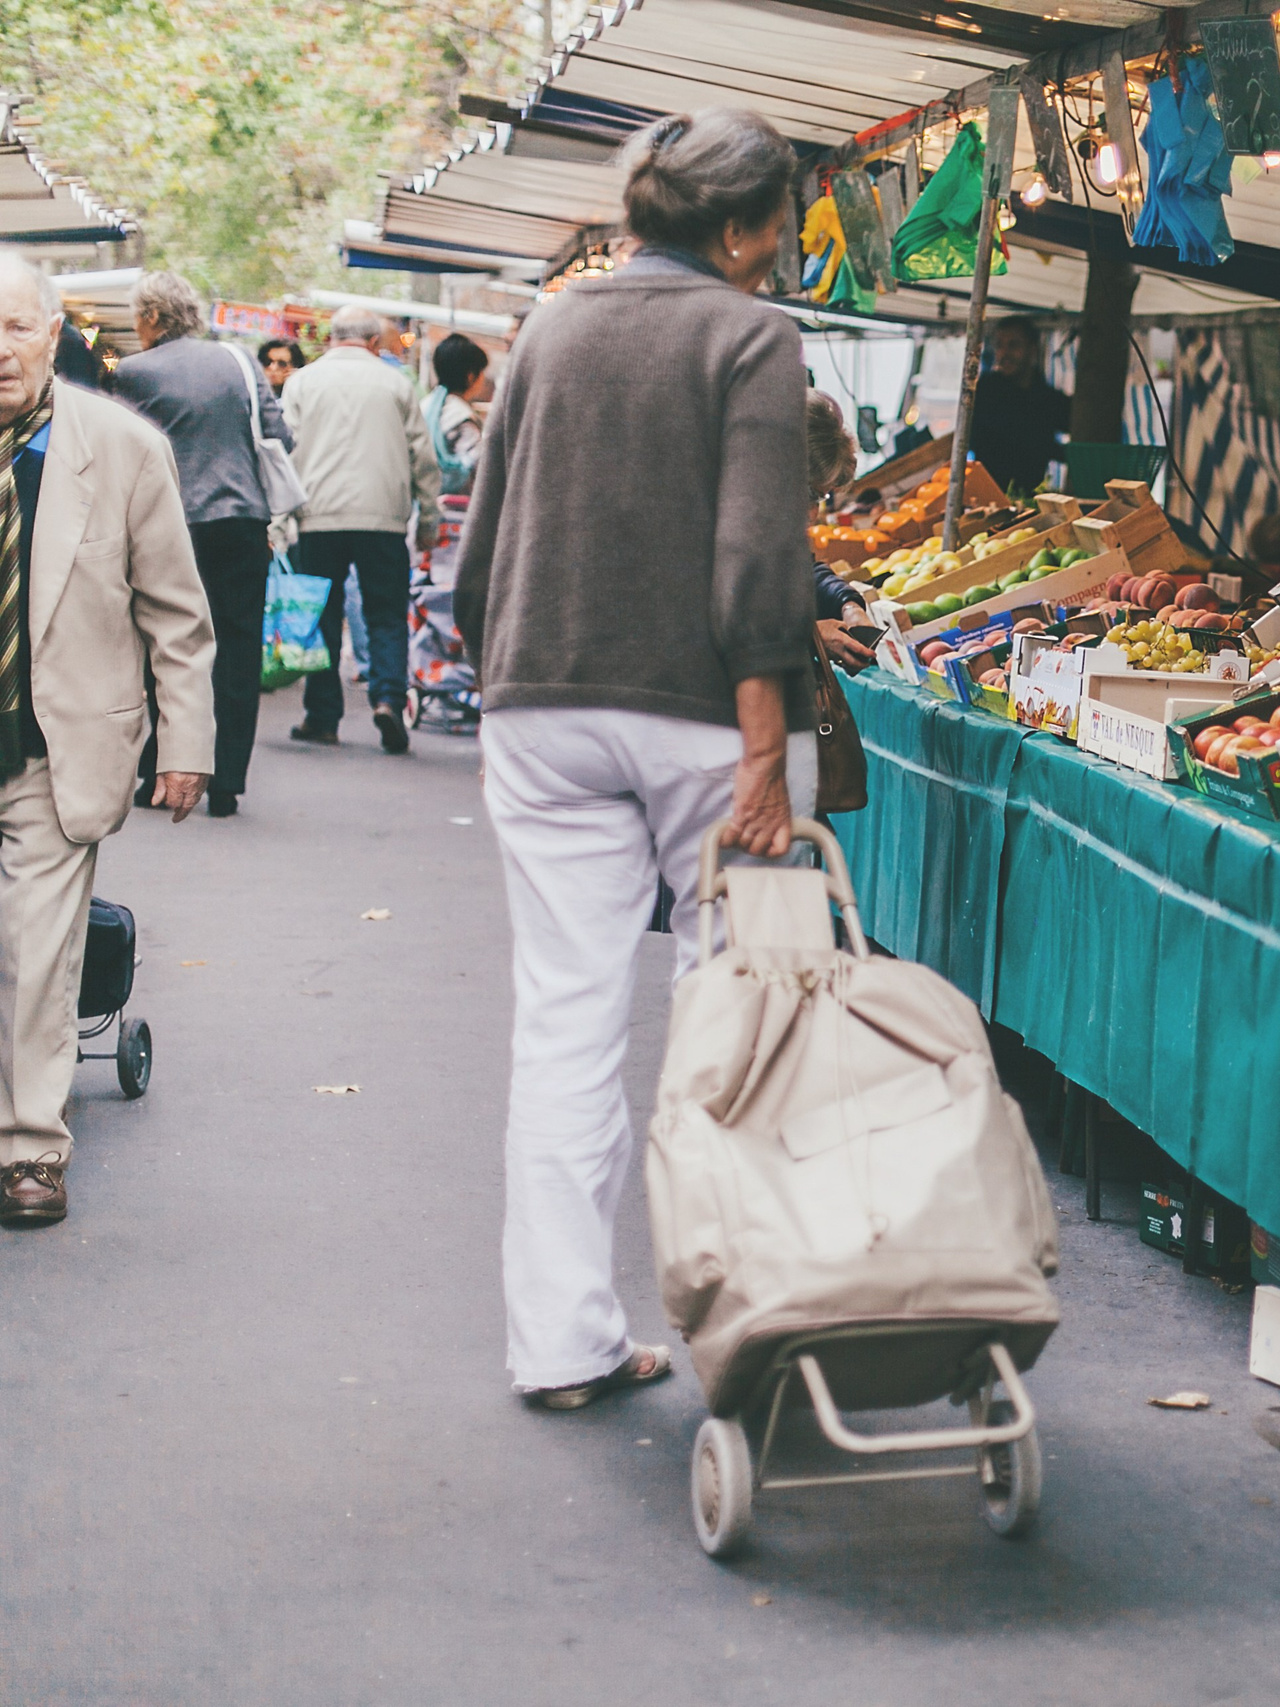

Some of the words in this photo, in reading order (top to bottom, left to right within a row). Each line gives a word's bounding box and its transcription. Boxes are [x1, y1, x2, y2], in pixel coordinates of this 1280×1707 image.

[1102, 714, 1113, 740] VAL
[1116, 719, 1123, 745] de
[1125, 723, 1154, 757] NESQUE
